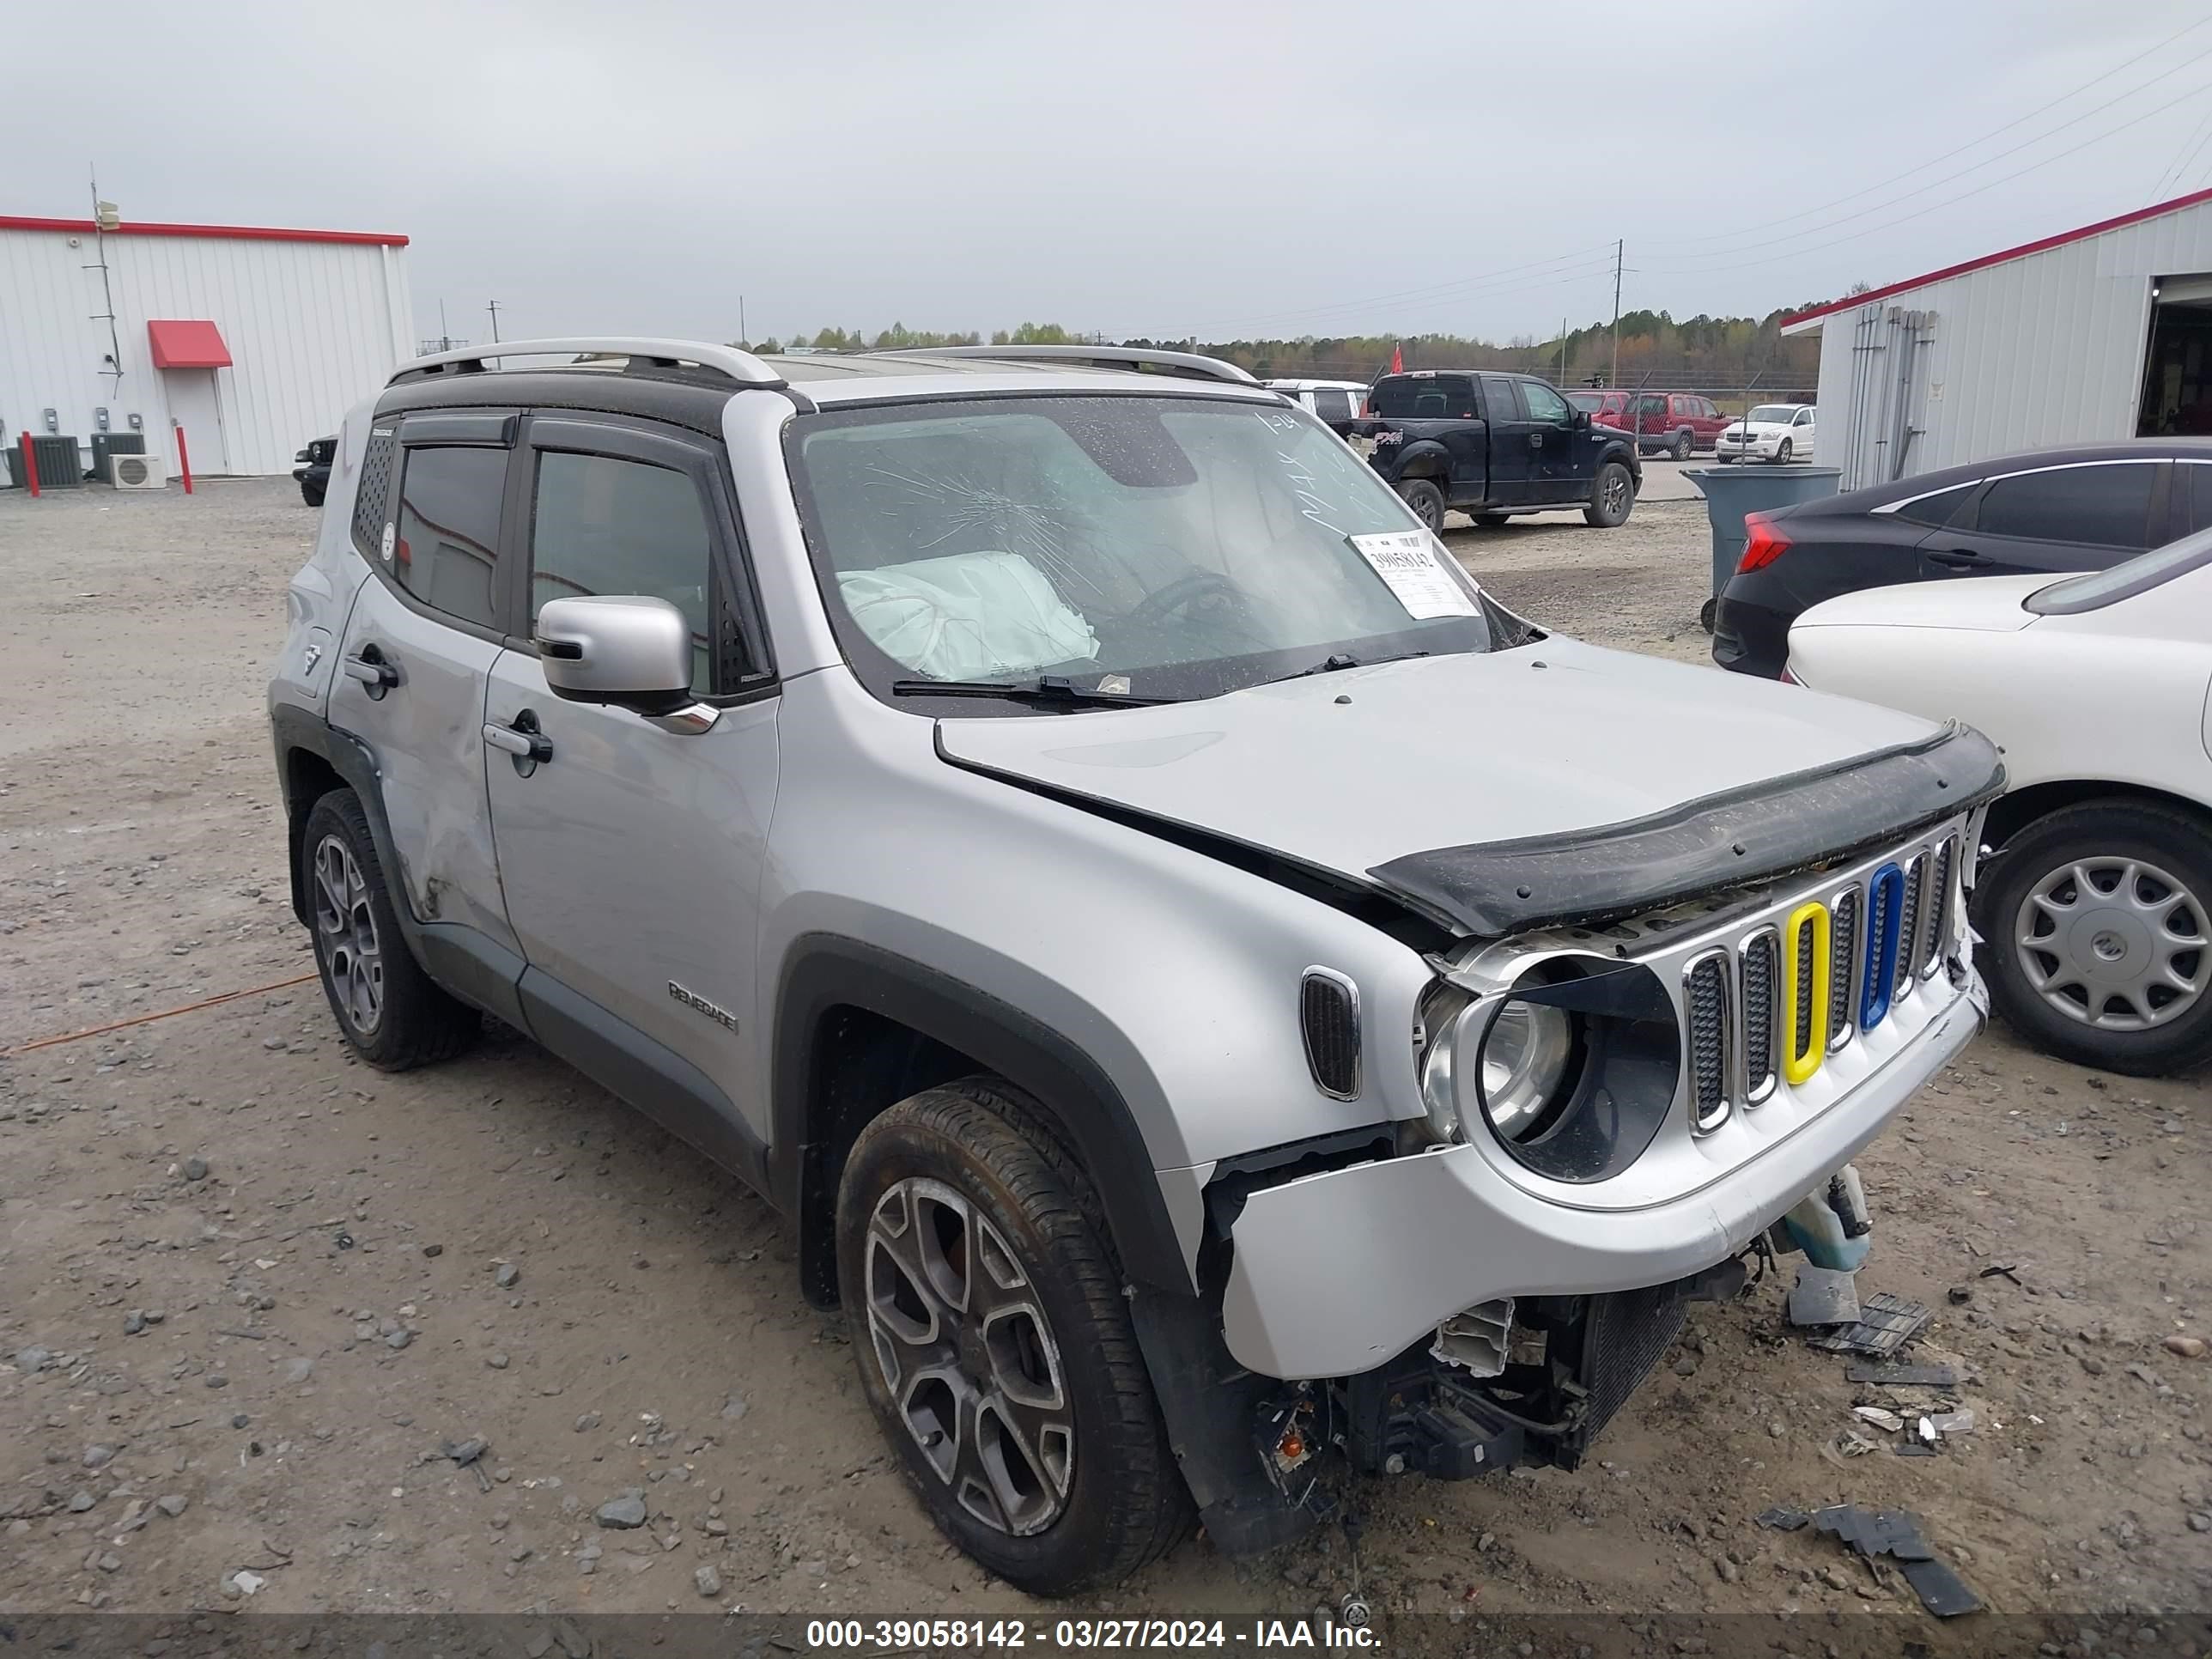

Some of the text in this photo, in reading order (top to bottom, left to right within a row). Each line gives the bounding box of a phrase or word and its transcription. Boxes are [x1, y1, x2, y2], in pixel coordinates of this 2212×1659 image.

[1374, 432, 1403, 444] FX4
[1370, 552, 1434, 568] 39058142
[667, 979, 738, 1035] RENEGADE
